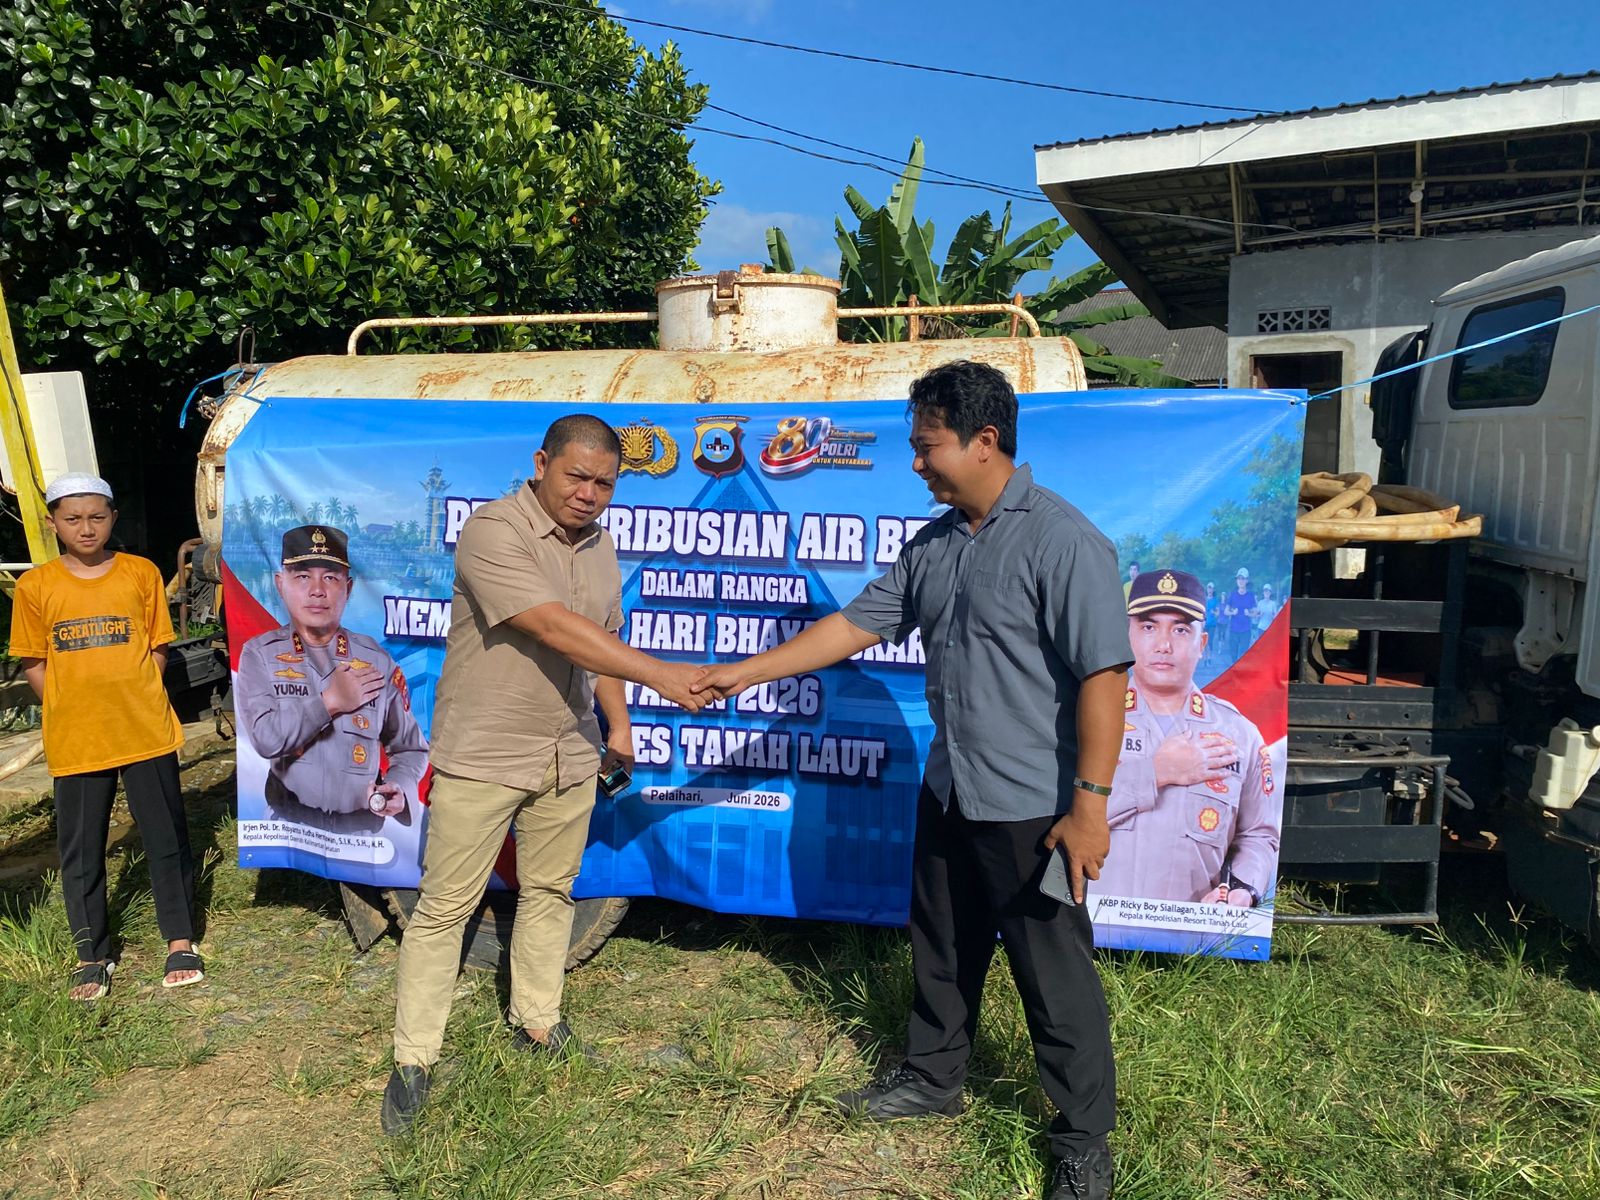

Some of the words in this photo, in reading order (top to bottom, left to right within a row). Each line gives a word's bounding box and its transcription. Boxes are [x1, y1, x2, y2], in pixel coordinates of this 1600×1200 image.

[819, 442, 857, 457] POLRI
[796, 516, 866, 562] AIR
[642, 571, 715, 599] DALAM
[721, 574, 808, 604] RANGKA
[628, 612, 709, 652] HARI
[273, 684, 309, 697] YUDHA
[736, 677, 820, 716] 2026
[680, 727, 790, 770] TANAH
[798, 736, 886, 777] LAUT
[650, 790, 704, 803] Pelaihari,
[726, 792, 751, 805] Juni
[754, 794, 781, 807] 2026
[243, 824, 258, 832] Irjen
[1099, 898, 1119, 908] AKBP
[1120, 900, 1142, 911] Ricky
[1143, 902, 1158, 913] Boy
[1160, 904, 1197, 916] Siallagan,
[1199, 907, 1224, 918] S.I.K.,
[1119, 911, 1143, 920] Kepala
[1145, 913, 1182, 923] Kepolisian
[1183, 916, 1206, 925] Resort
[1209, 919, 1230, 927] Tanah
